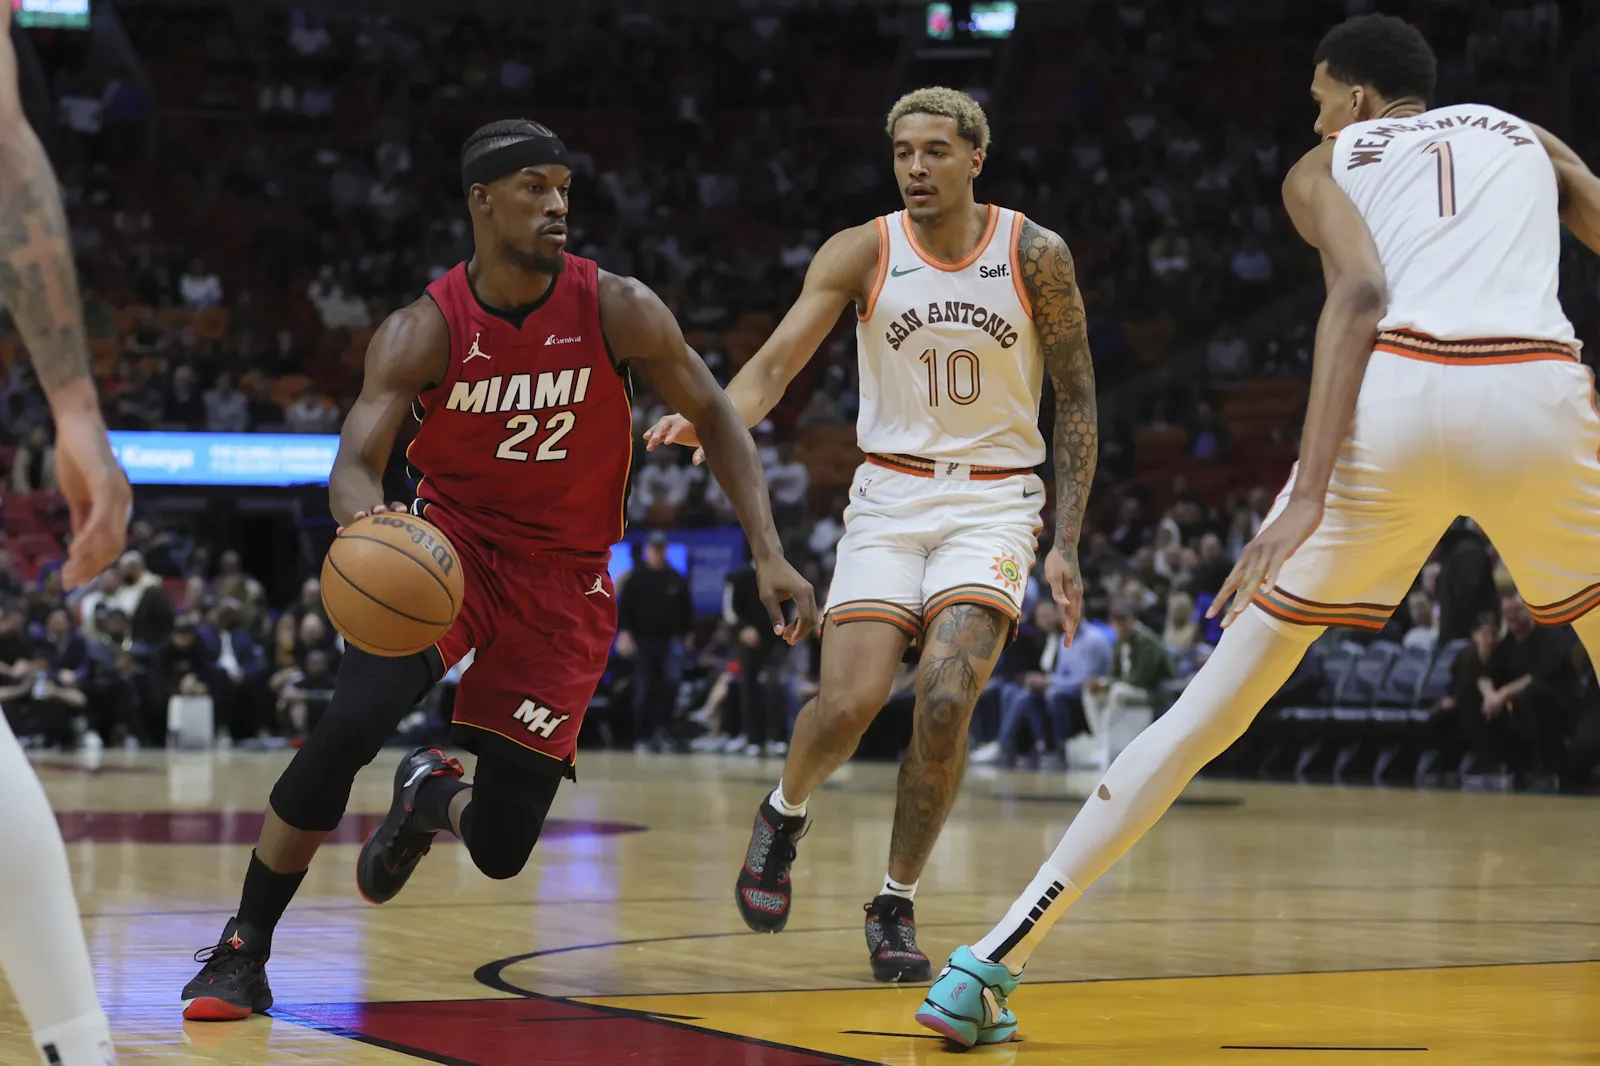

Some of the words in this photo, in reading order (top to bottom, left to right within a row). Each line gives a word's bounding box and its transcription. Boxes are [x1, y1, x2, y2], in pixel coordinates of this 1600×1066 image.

[1420, 141, 1456, 218] 1
[979, 264, 1010, 279] Self.
[552, 335, 582, 345] Carnival
[885, 308, 924, 351] SAN
[928, 301, 1018, 349] ANTONIO
[445, 367, 592, 413] MIAMI
[919, 349, 980, 407] 10
[495, 410, 576, 461] 22
